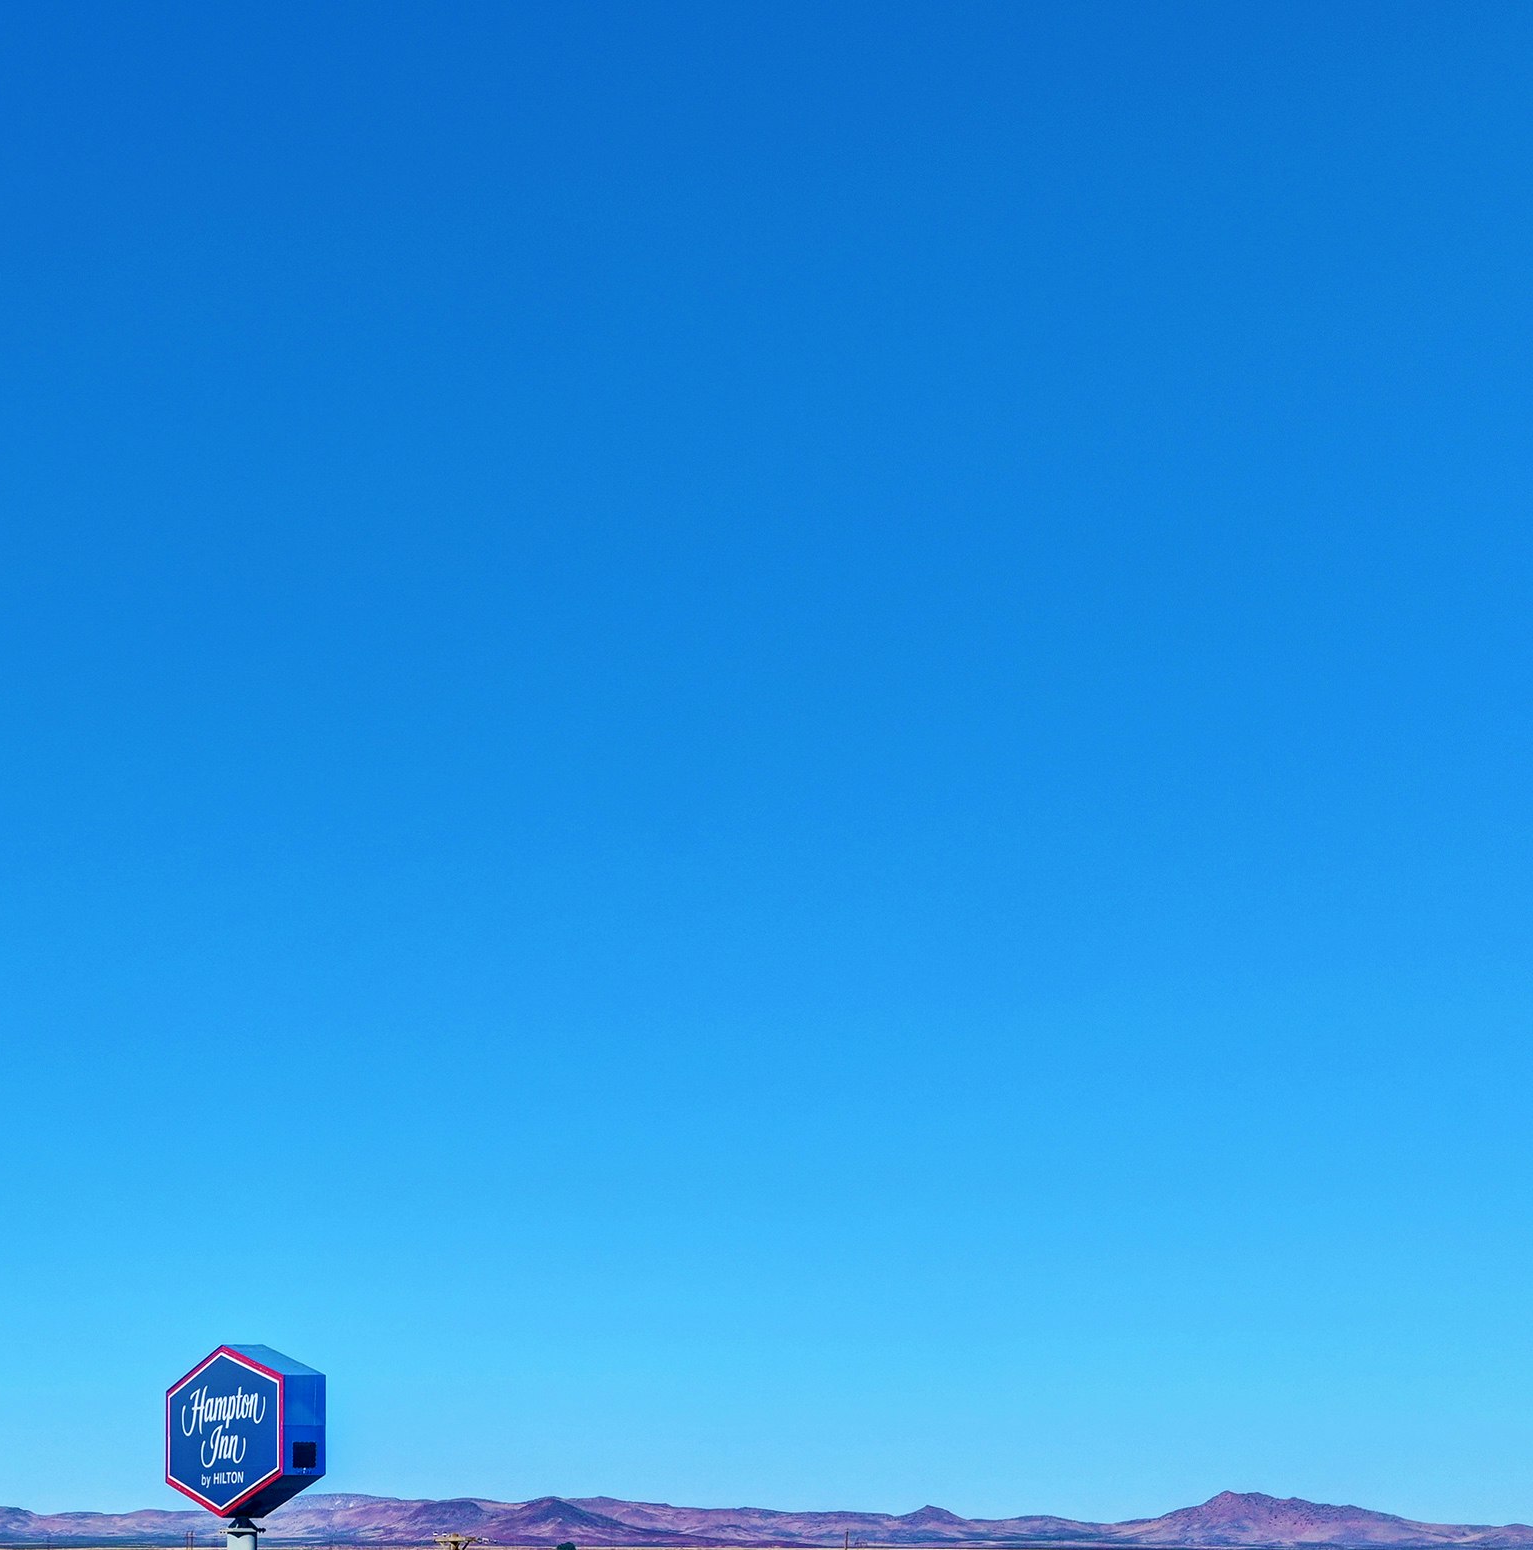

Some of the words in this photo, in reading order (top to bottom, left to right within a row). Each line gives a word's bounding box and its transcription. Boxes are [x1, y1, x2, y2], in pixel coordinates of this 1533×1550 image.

[181, 1385, 266, 1437] Hampton
[200, 1424, 246, 1468] Inn
[201, 1473, 212, 1488] by
[213, 1471, 244, 1484] HILTON
